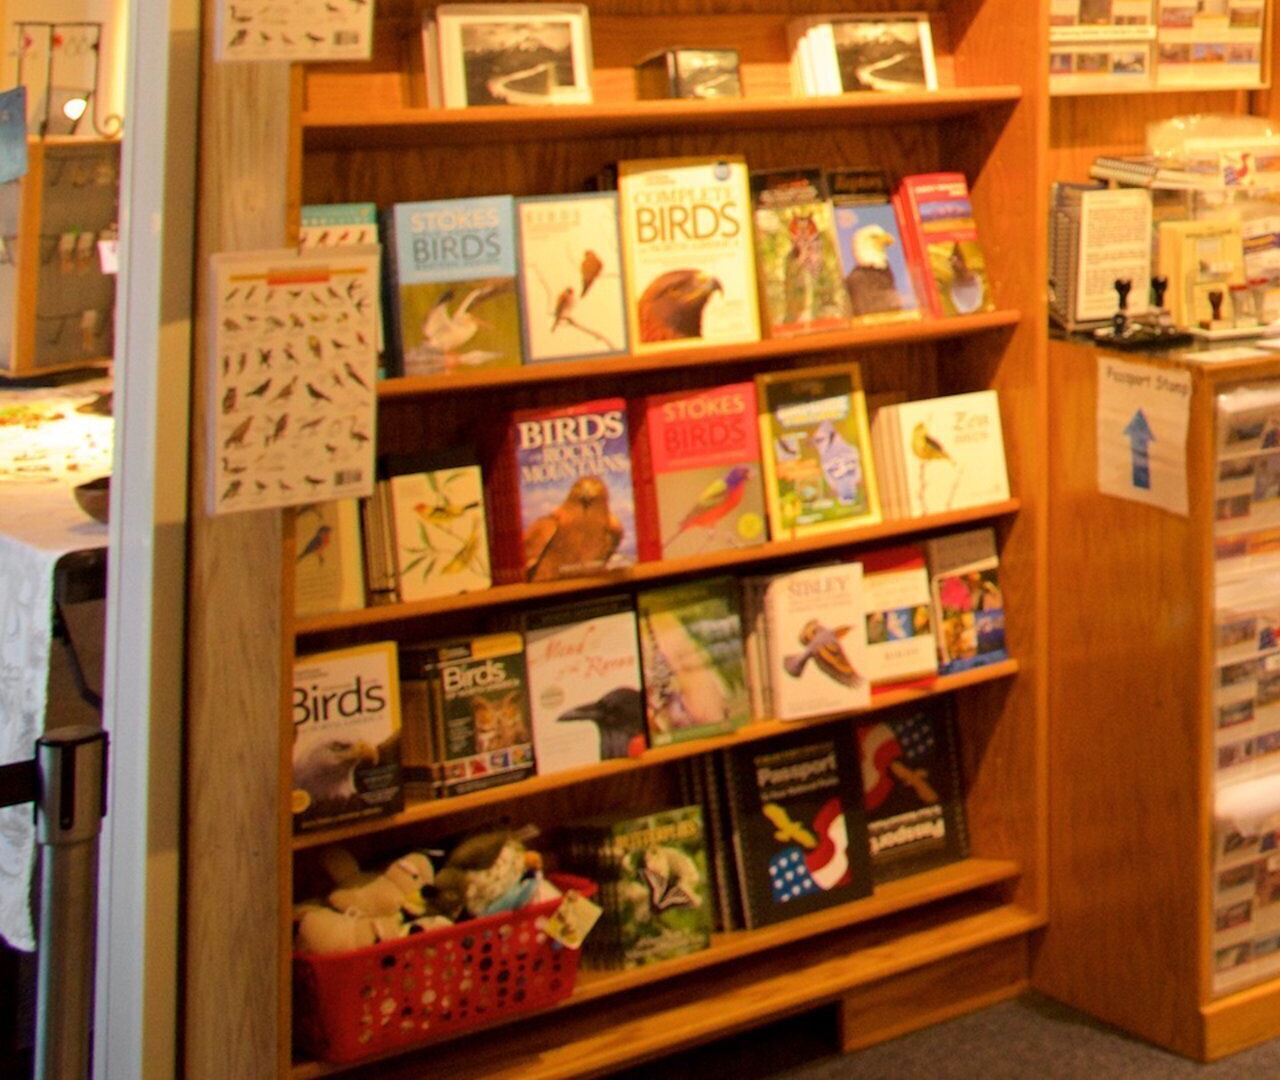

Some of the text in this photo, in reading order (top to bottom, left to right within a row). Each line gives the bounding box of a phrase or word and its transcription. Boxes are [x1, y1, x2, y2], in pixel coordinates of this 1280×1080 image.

[410, 207, 501, 234] STOKES
[635, 201, 741, 245] BIRDS
[413, 231, 502, 265] BIRDS
[661, 395, 746, 423] STOKES
[518, 410, 626, 451] BIRDS
[662, 419, 748, 454] BIRDS
[521, 452, 631, 483] MOUNTAINS
[542, 439, 607, 464] ROCKY
[443, 659, 508, 692] Birds
[293, 675, 386, 726] Birds
